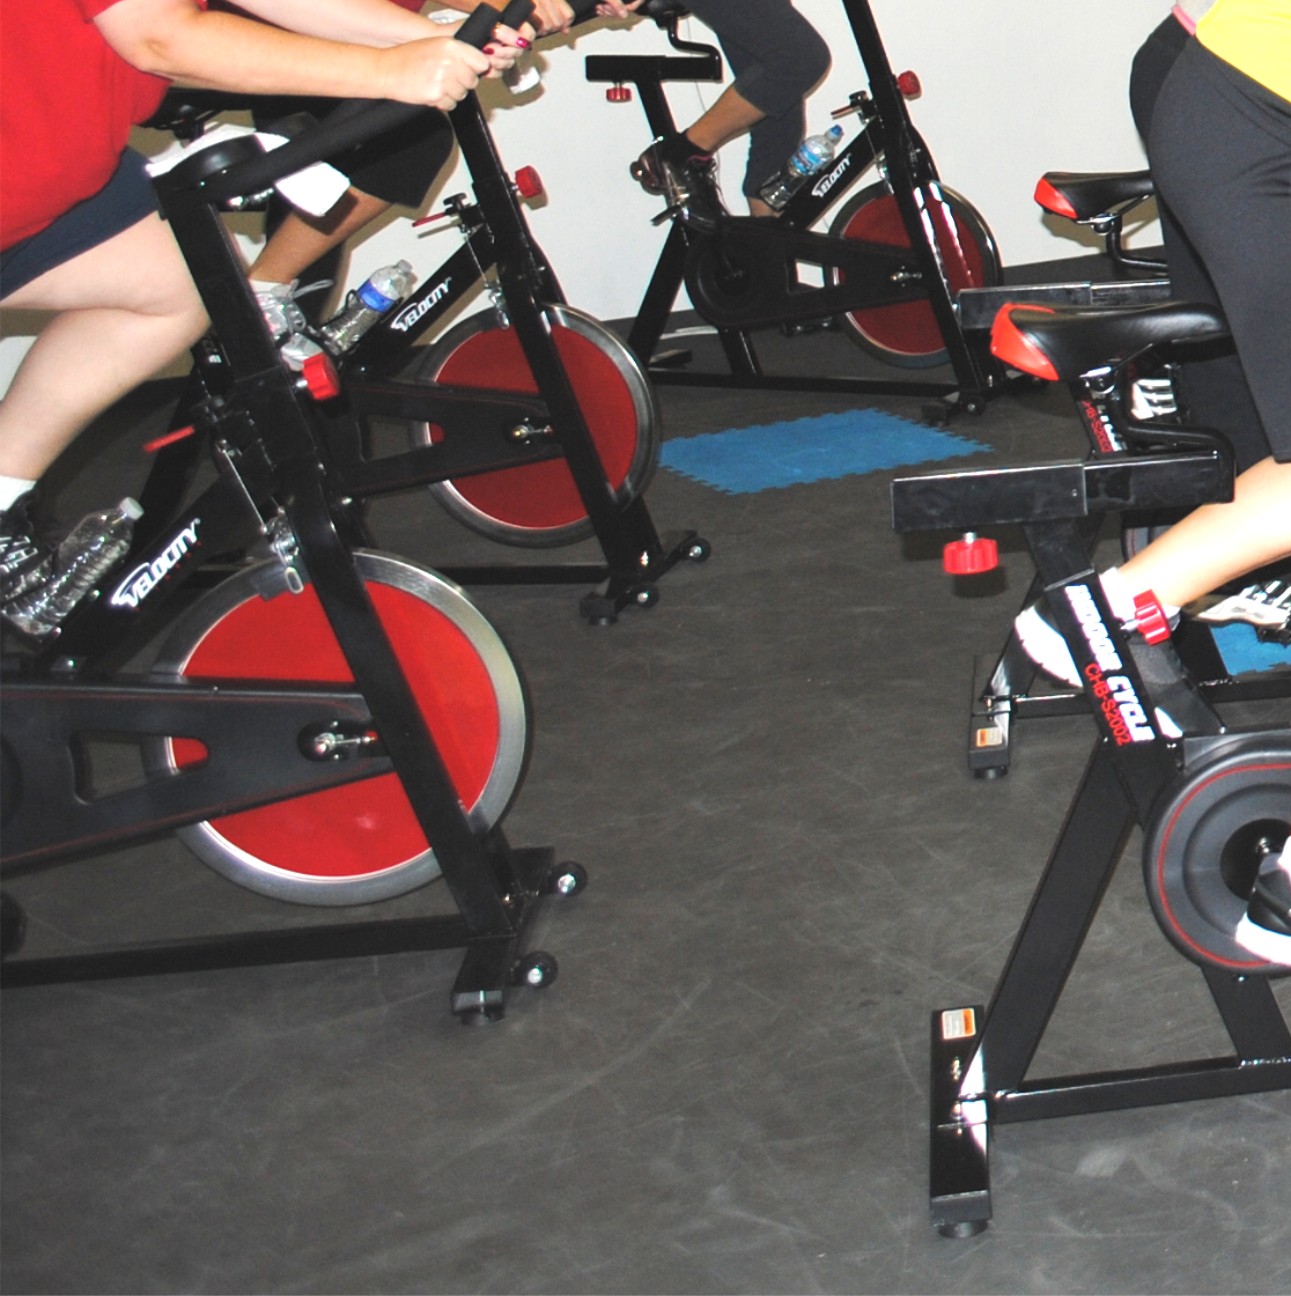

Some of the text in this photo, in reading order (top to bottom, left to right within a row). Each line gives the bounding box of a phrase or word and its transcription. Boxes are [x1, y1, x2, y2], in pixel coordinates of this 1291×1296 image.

[811, 153, 851, 198] VELOCITY
[391, 277, 452, 332] VELOCITY
[111, 518, 200, 607] VELOCITY
[1084, 662, 1132, 746] CHB-S2002
[1106, 675, 1156, 743] CYCLE
